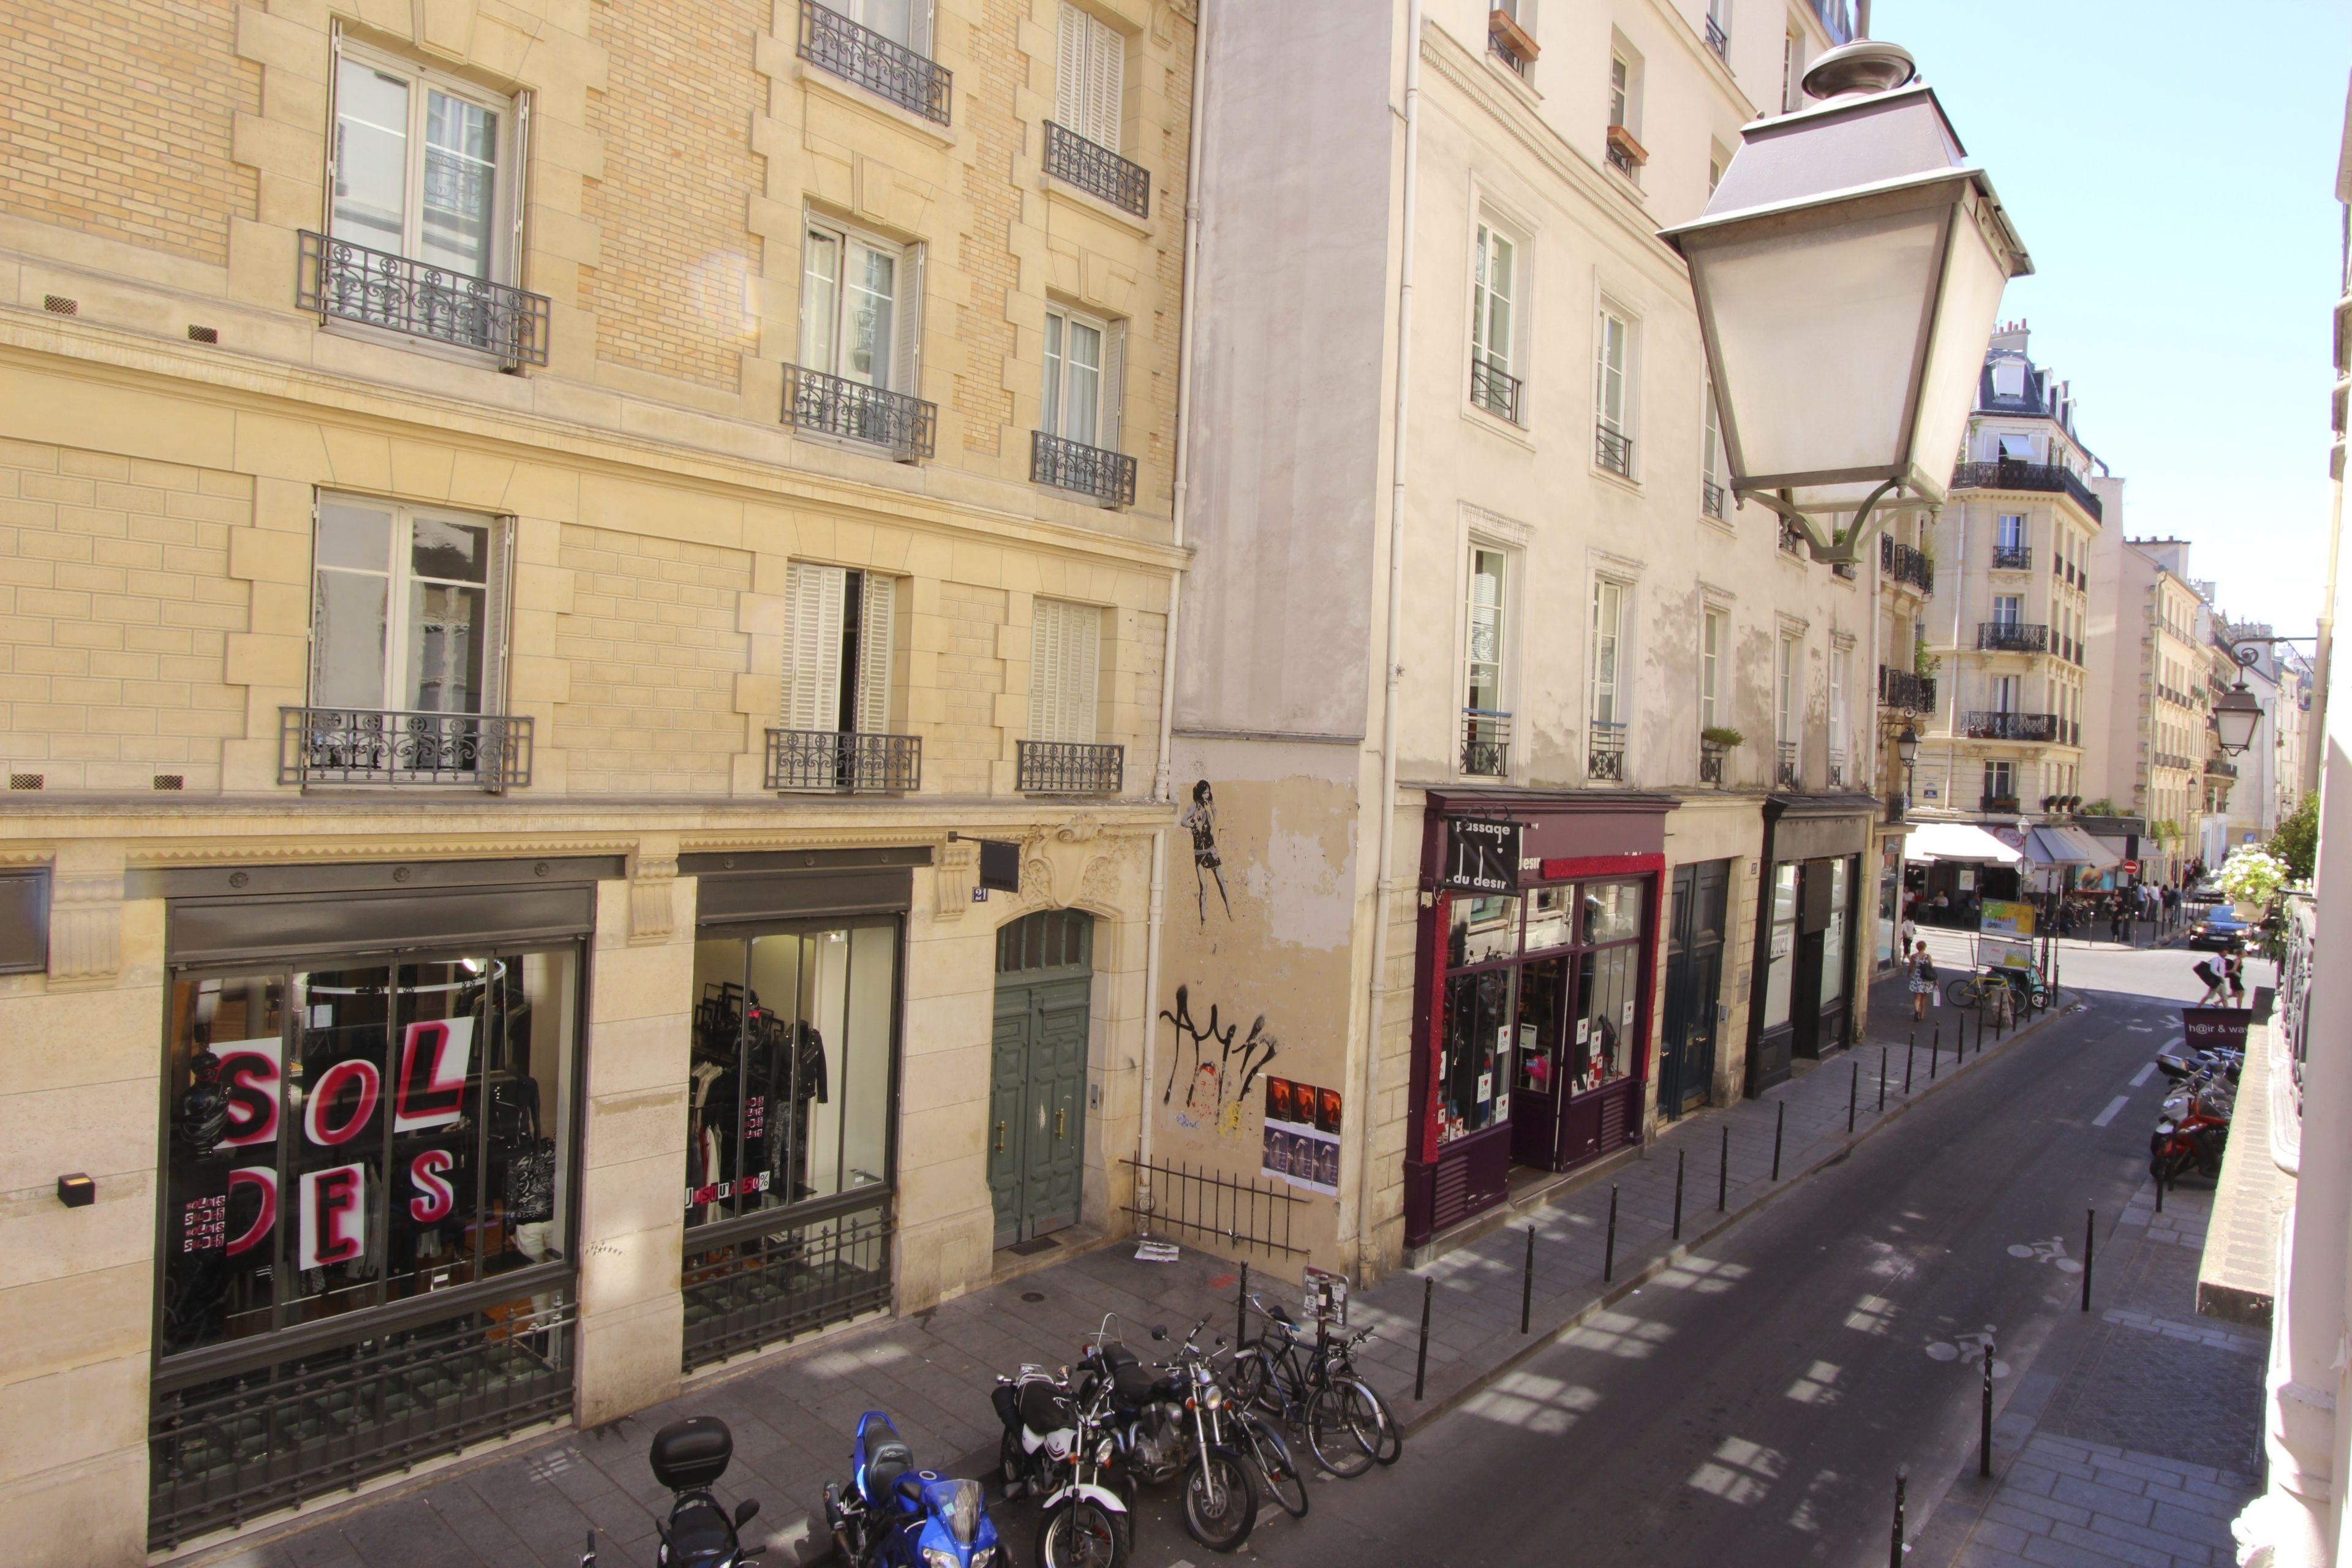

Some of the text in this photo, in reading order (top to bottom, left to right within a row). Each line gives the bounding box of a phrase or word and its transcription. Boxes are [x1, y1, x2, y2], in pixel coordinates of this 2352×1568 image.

[1453, 843, 1470, 885] du
[975, 889, 987, 900] 21
[2188, 1023, 2214, 1035] h@ir
[2218, 1024, 2226, 1033] &
[742, 1172, 770, 1193] 50%
